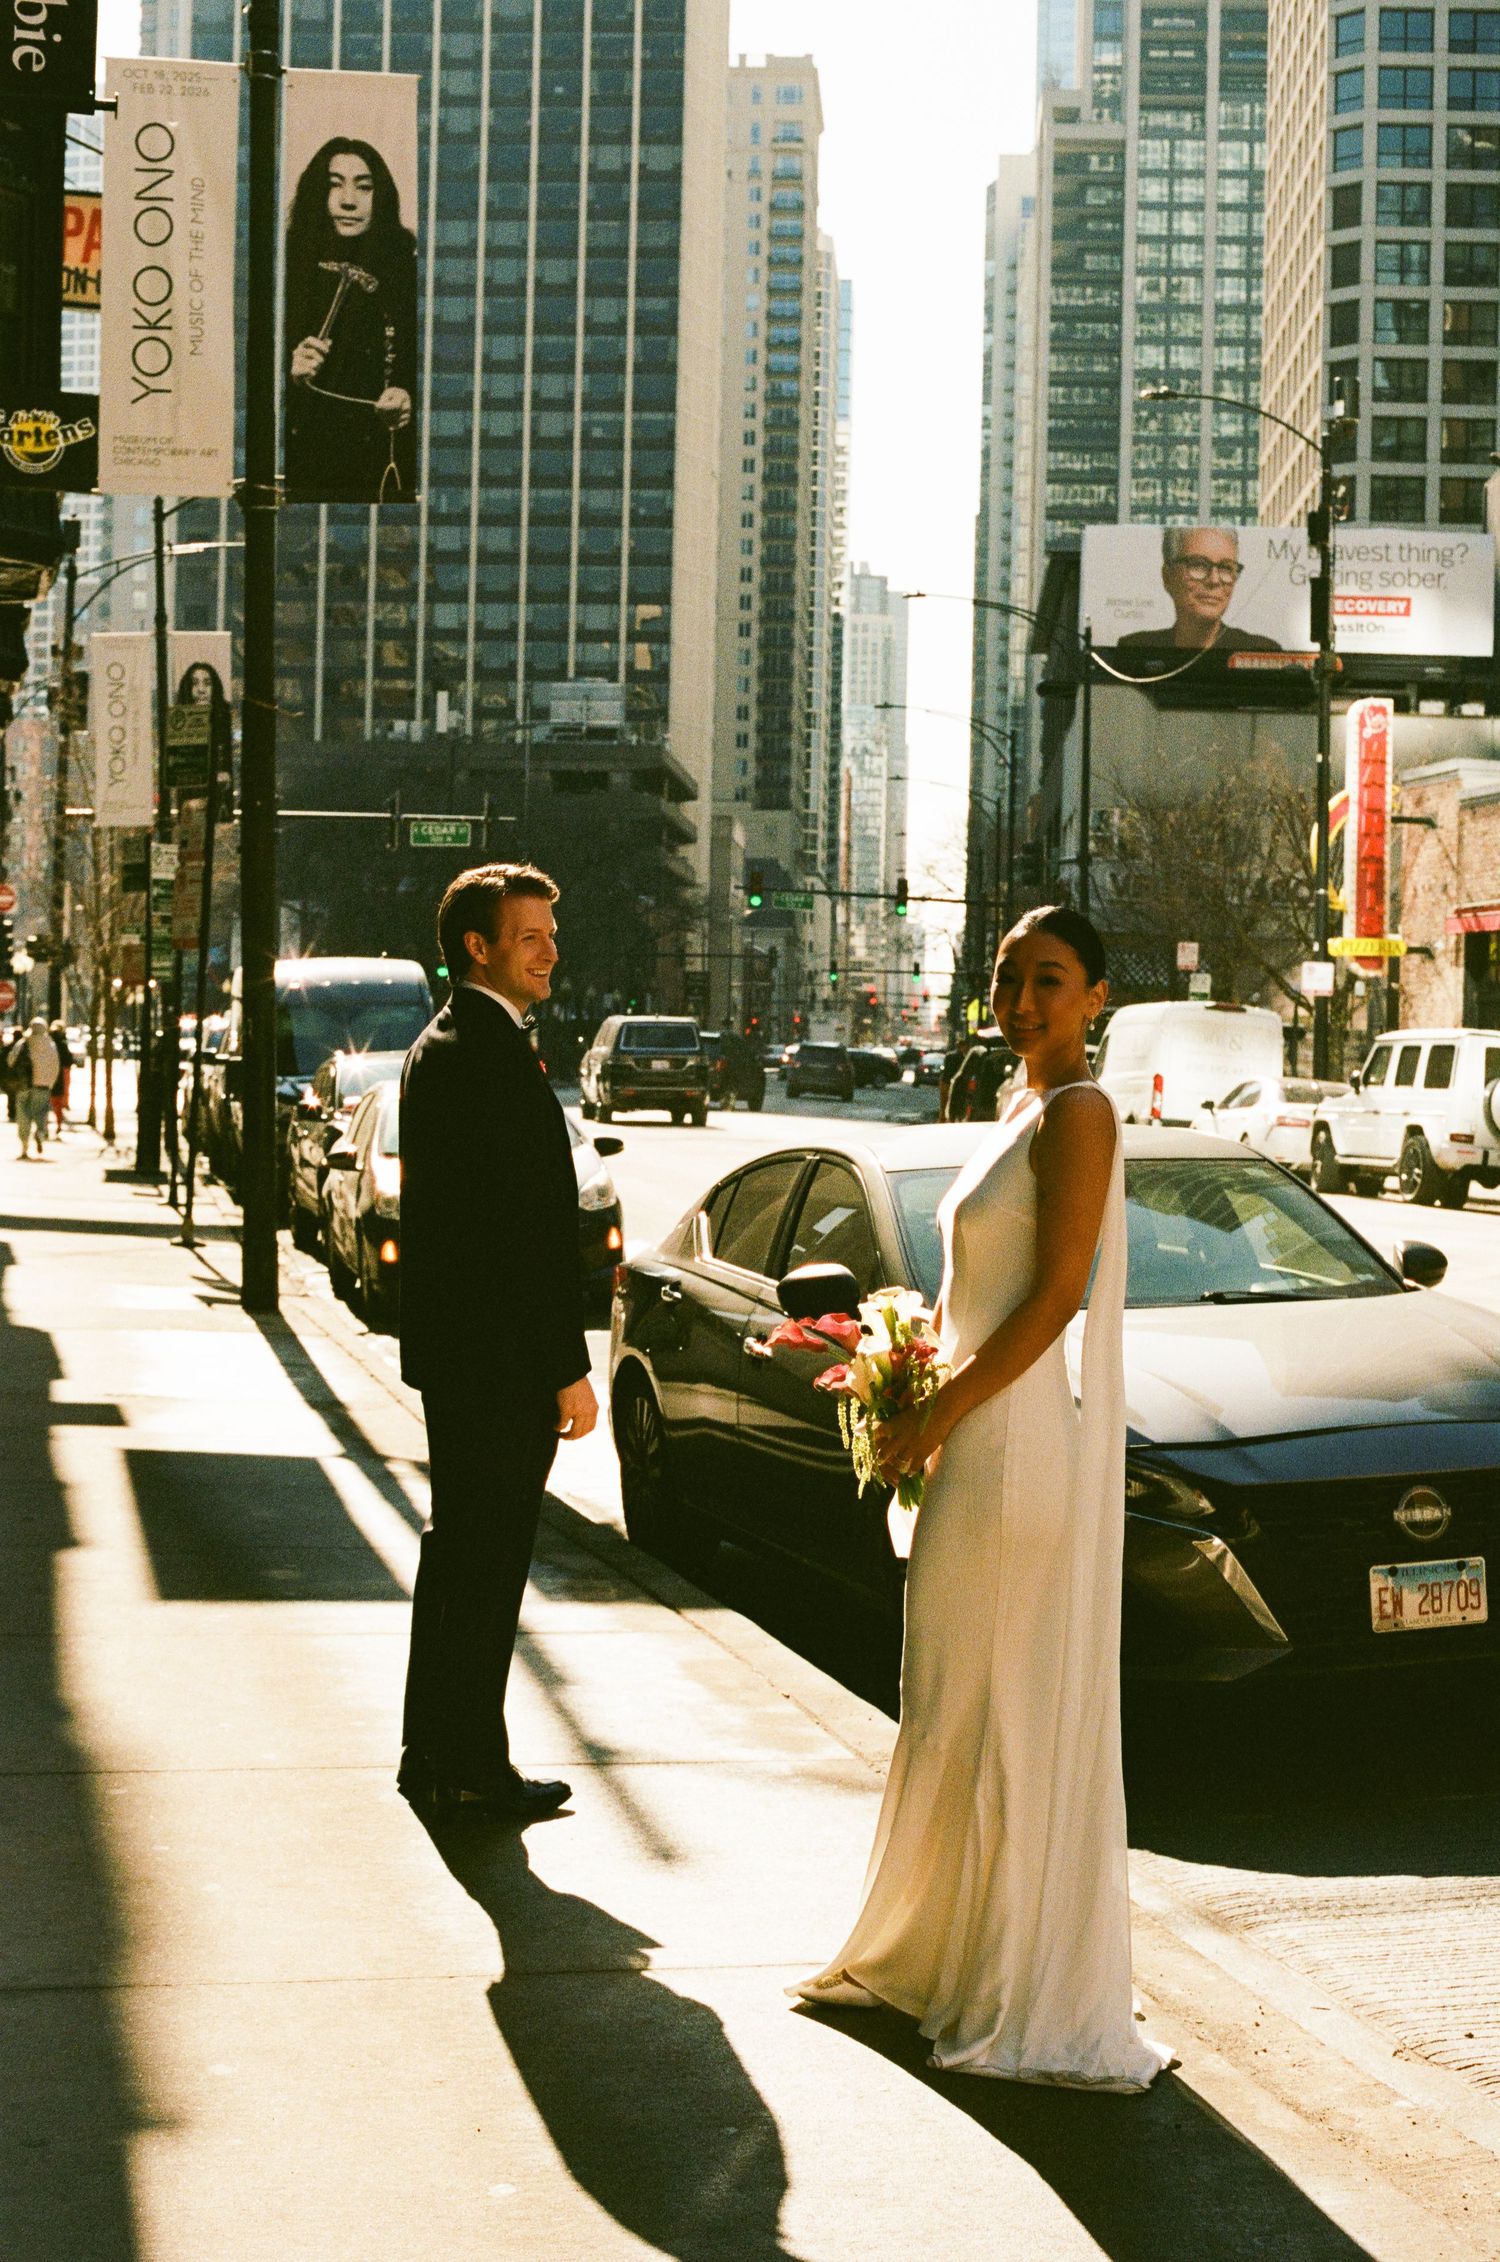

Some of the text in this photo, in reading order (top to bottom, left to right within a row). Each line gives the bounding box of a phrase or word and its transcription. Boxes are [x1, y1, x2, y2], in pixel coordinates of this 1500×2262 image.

[122, 68, 149, 79] OCT
[132, 82, 154, 95] FEB
[180, 86, 210, 97] 2026
[131, 122, 174, 404] YOKO ONO
[189, 177, 206, 356] MUSIC OF THE MIND
[1267, 539, 1470, 568] My bavest thing?
[1289, 564, 1449, 592] Geing sober.
[1334, 599, 1408, 614] ECOVERY
[106, 661, 127, 719] ONO
[108, 726, 127, 787] YOKO
[420, 824, 457, 835] CEDAR
[1341, 940, 1401, 955] PIZZERIA
[1401, 1563, 1457, 1577] ILLINOIS
[1418, 1577, 1482, 1616] 28709
